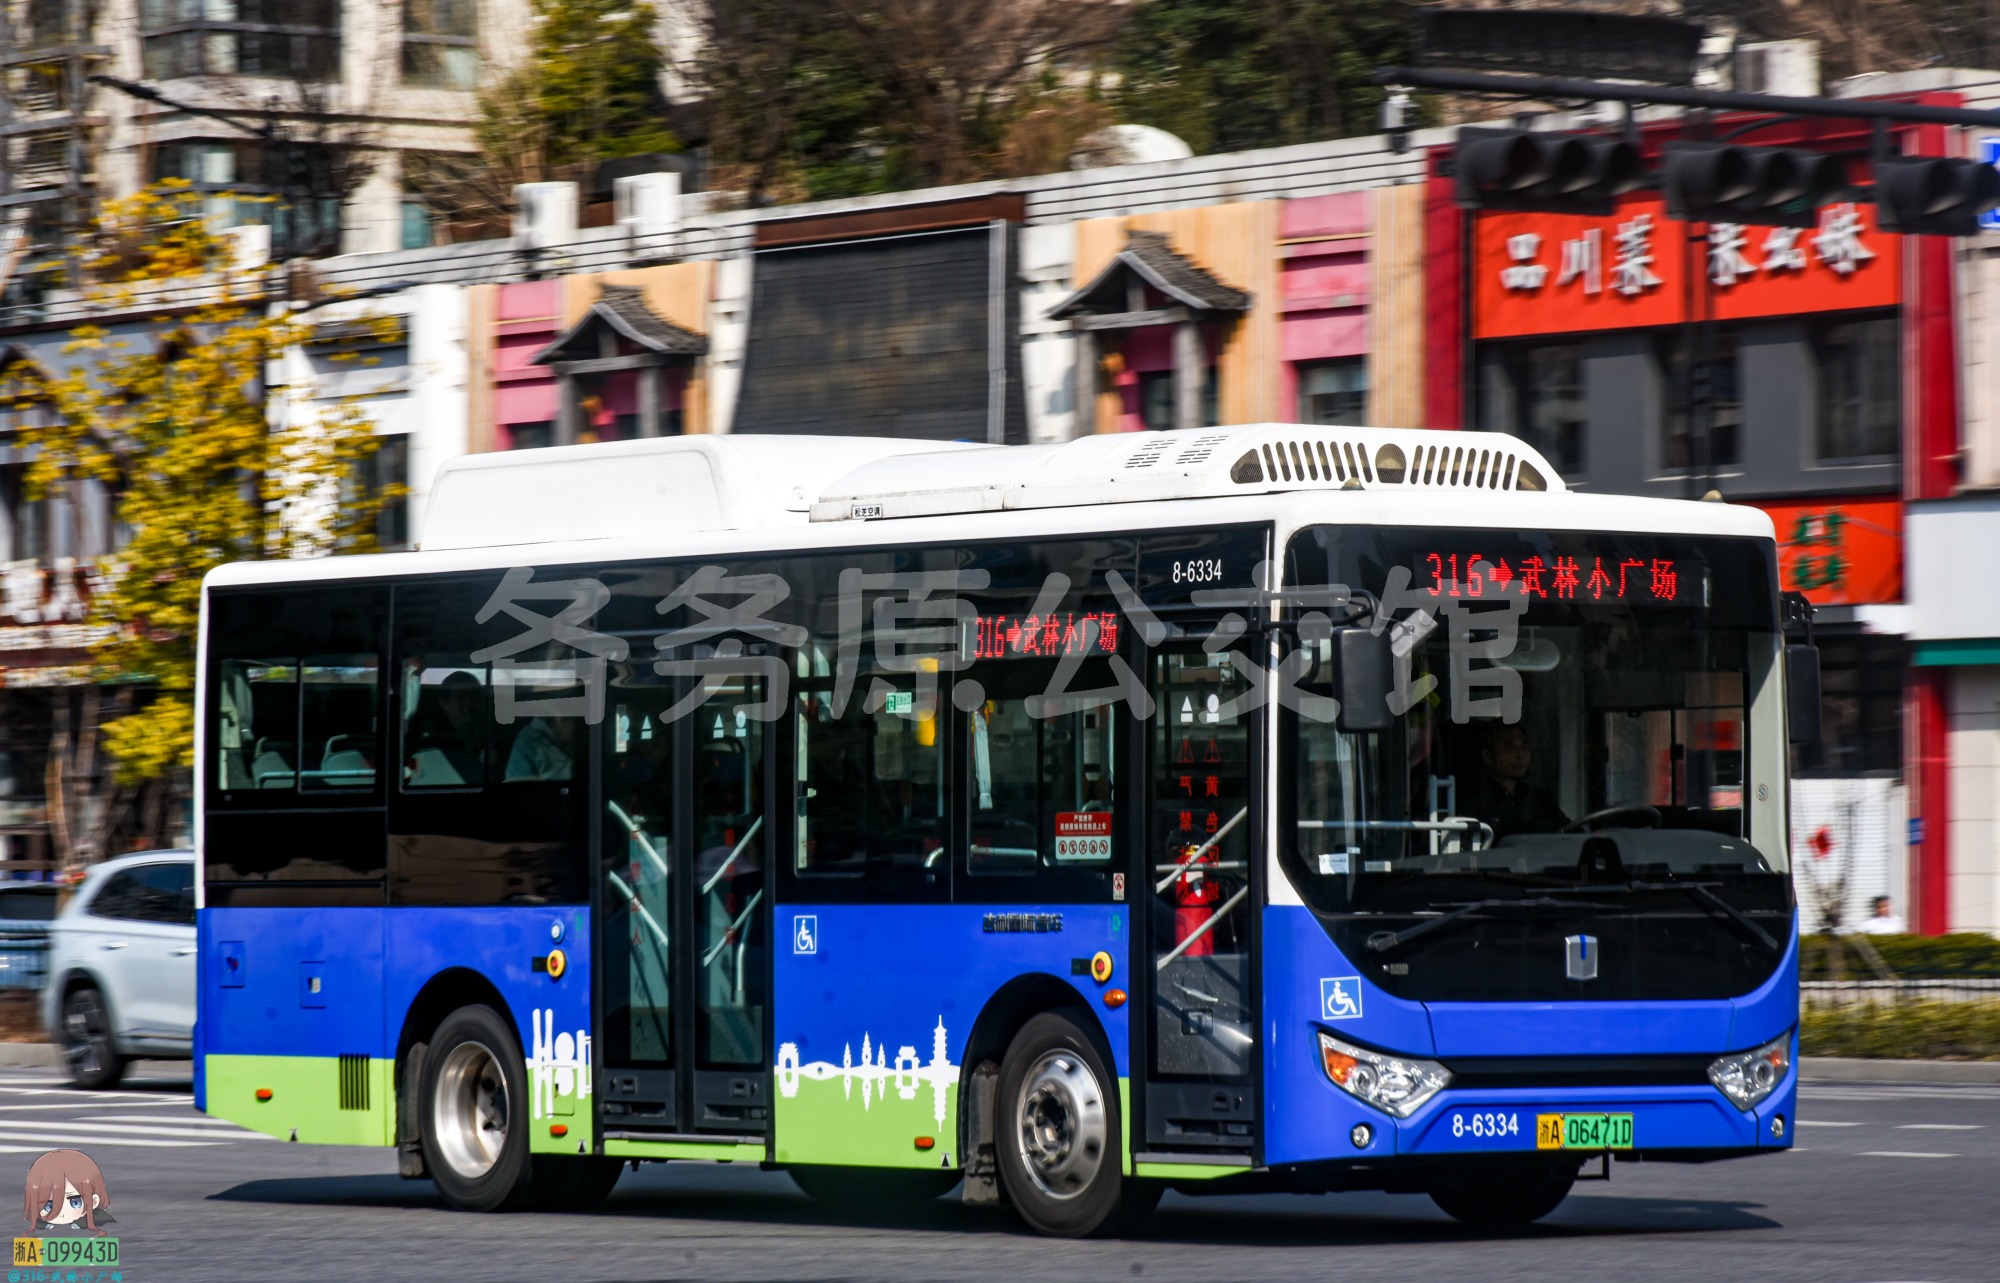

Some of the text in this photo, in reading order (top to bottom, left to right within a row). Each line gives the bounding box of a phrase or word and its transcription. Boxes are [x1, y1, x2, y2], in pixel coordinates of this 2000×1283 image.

[1499, 213, 1664, 295] 品川菜
[1173, 559, 1222, 583] 8-6334
[1427, 553, 1678, 600] 316 武林小广场
[974, 611, 1118, 658] 316 武林小广场
[1452, 1113, 1519, 1137] 8-6334
